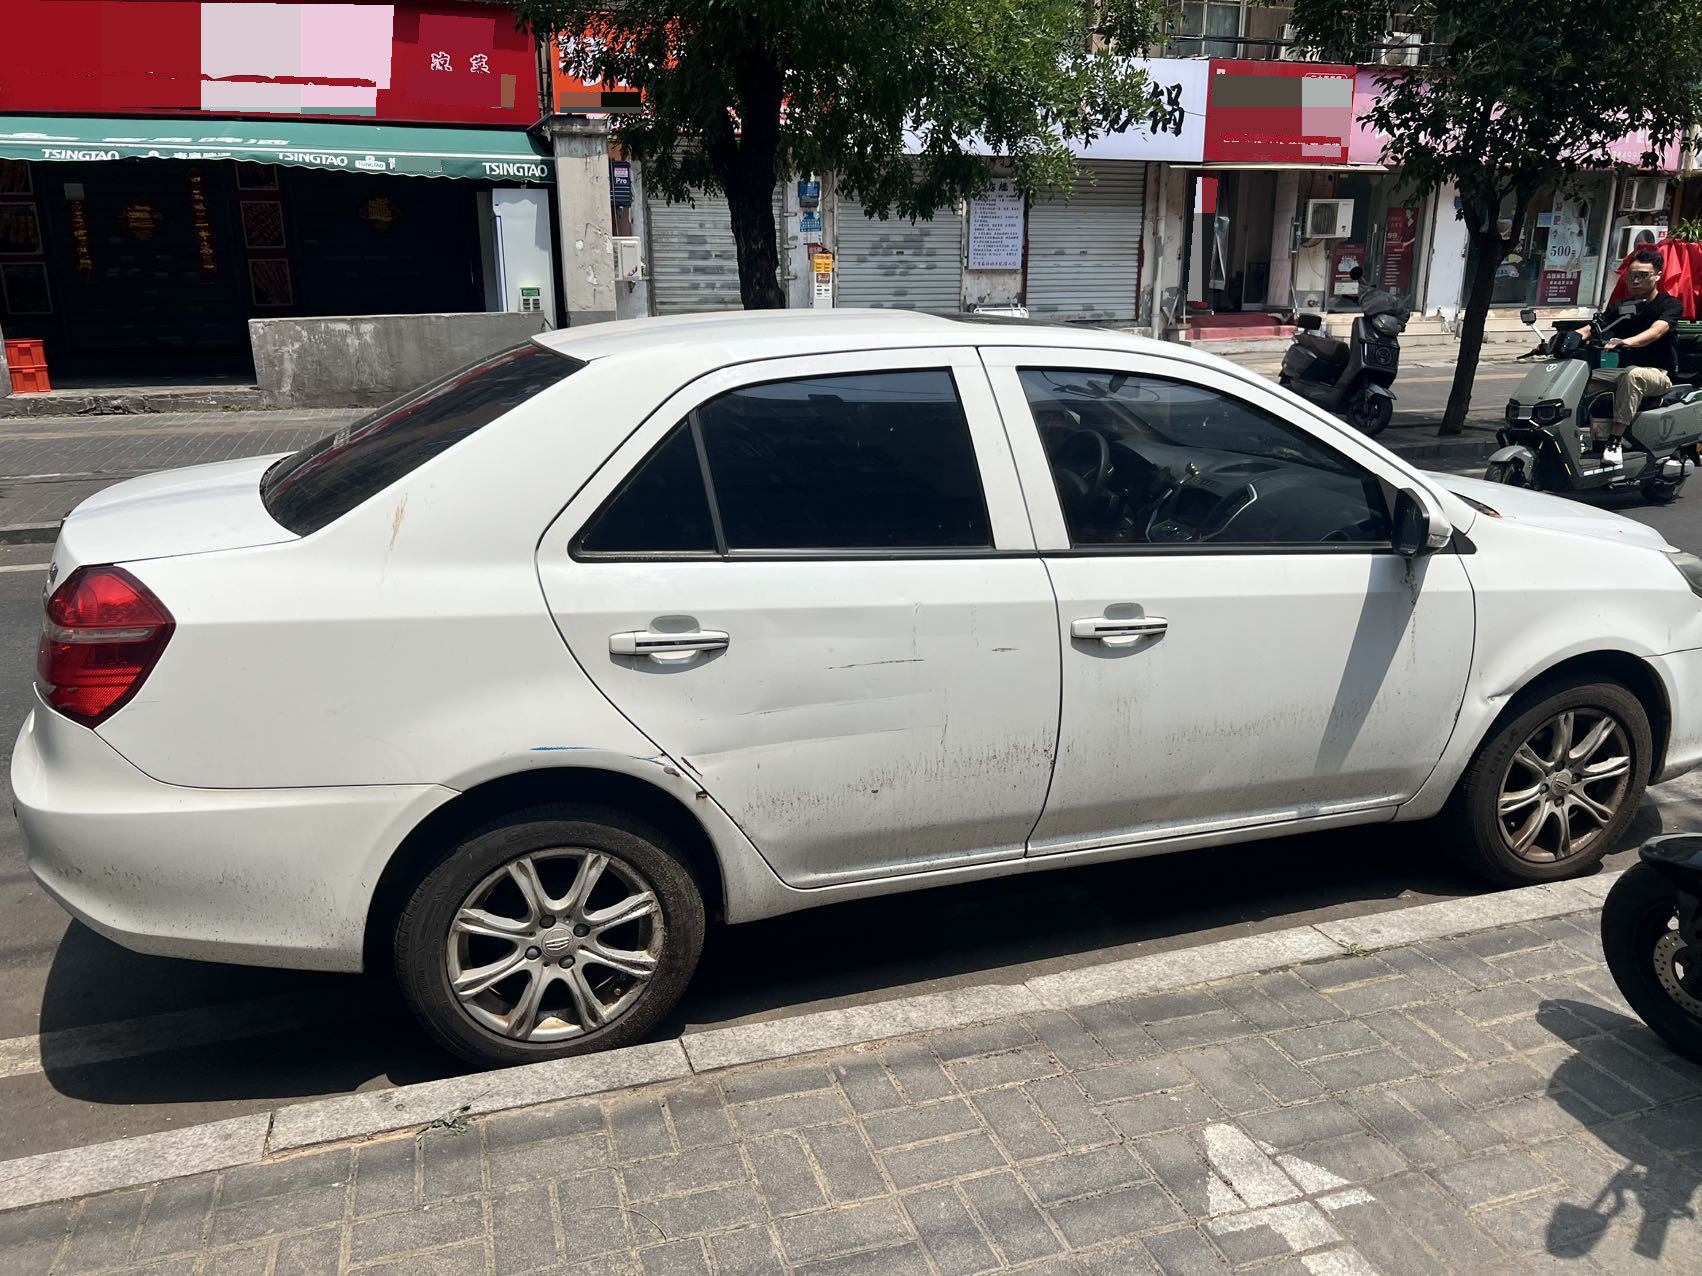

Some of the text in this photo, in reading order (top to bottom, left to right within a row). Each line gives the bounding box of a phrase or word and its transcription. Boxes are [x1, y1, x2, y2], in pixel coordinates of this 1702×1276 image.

[41, 148, 120, 161] TSINGTAO
[278, 152, 349, 167] TSINGTAO
[482, 162, 548, 177] TSINGTAO
